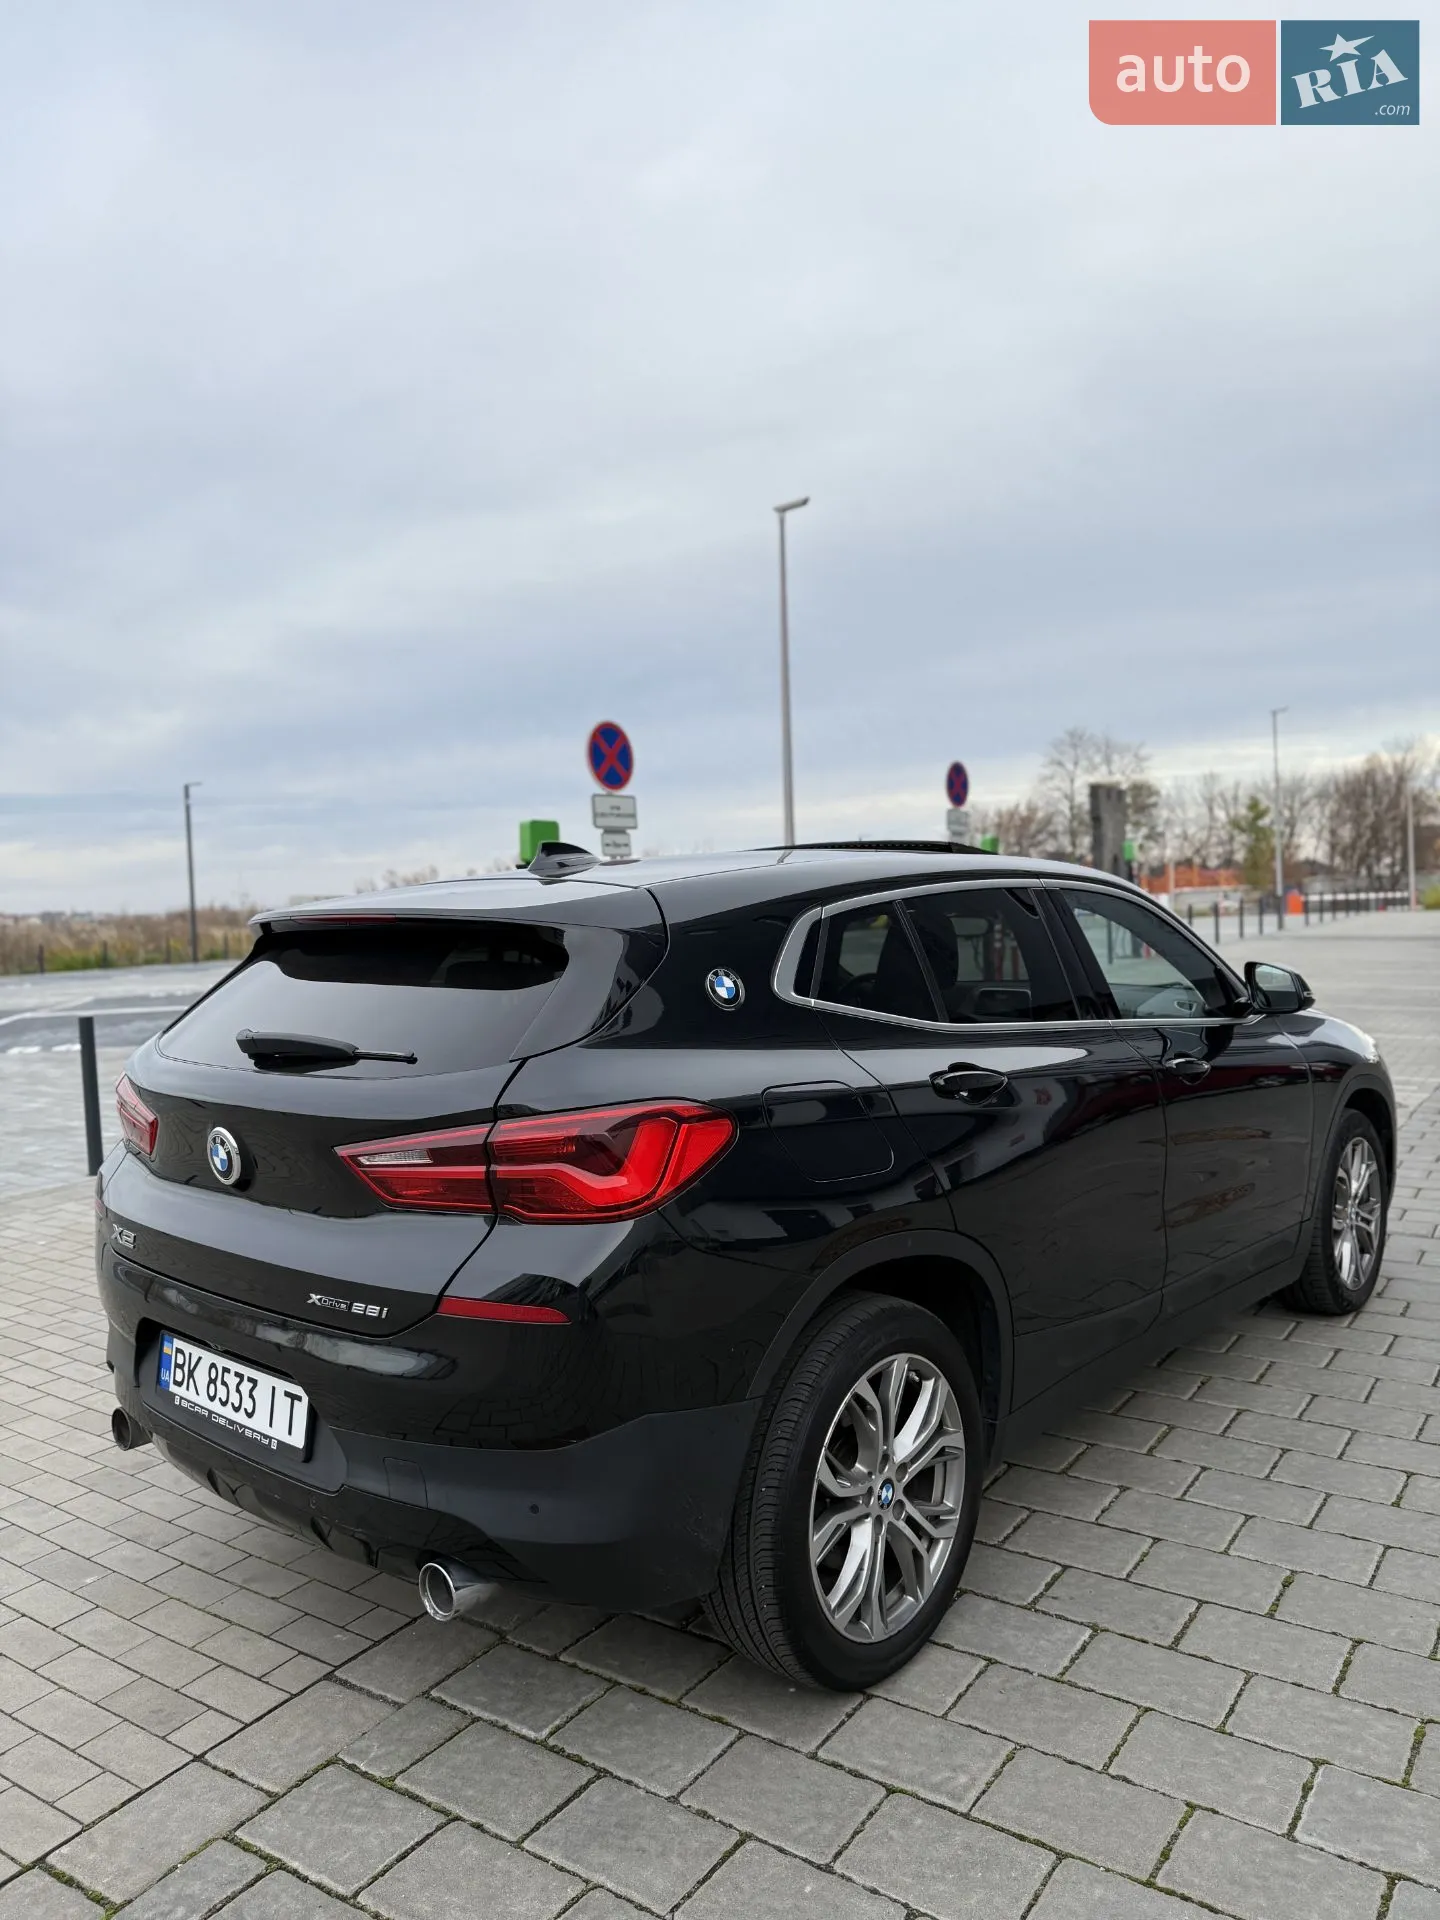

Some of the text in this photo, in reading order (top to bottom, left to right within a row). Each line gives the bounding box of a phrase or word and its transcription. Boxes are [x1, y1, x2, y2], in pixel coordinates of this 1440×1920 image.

[111, 1223, 137, 1250] X2
[160, 1368, 170, 1383] UA
[172, 1346, 303, 1437] BK 8533 IT
[211, 1413, 270, 1446] DELIVERY
